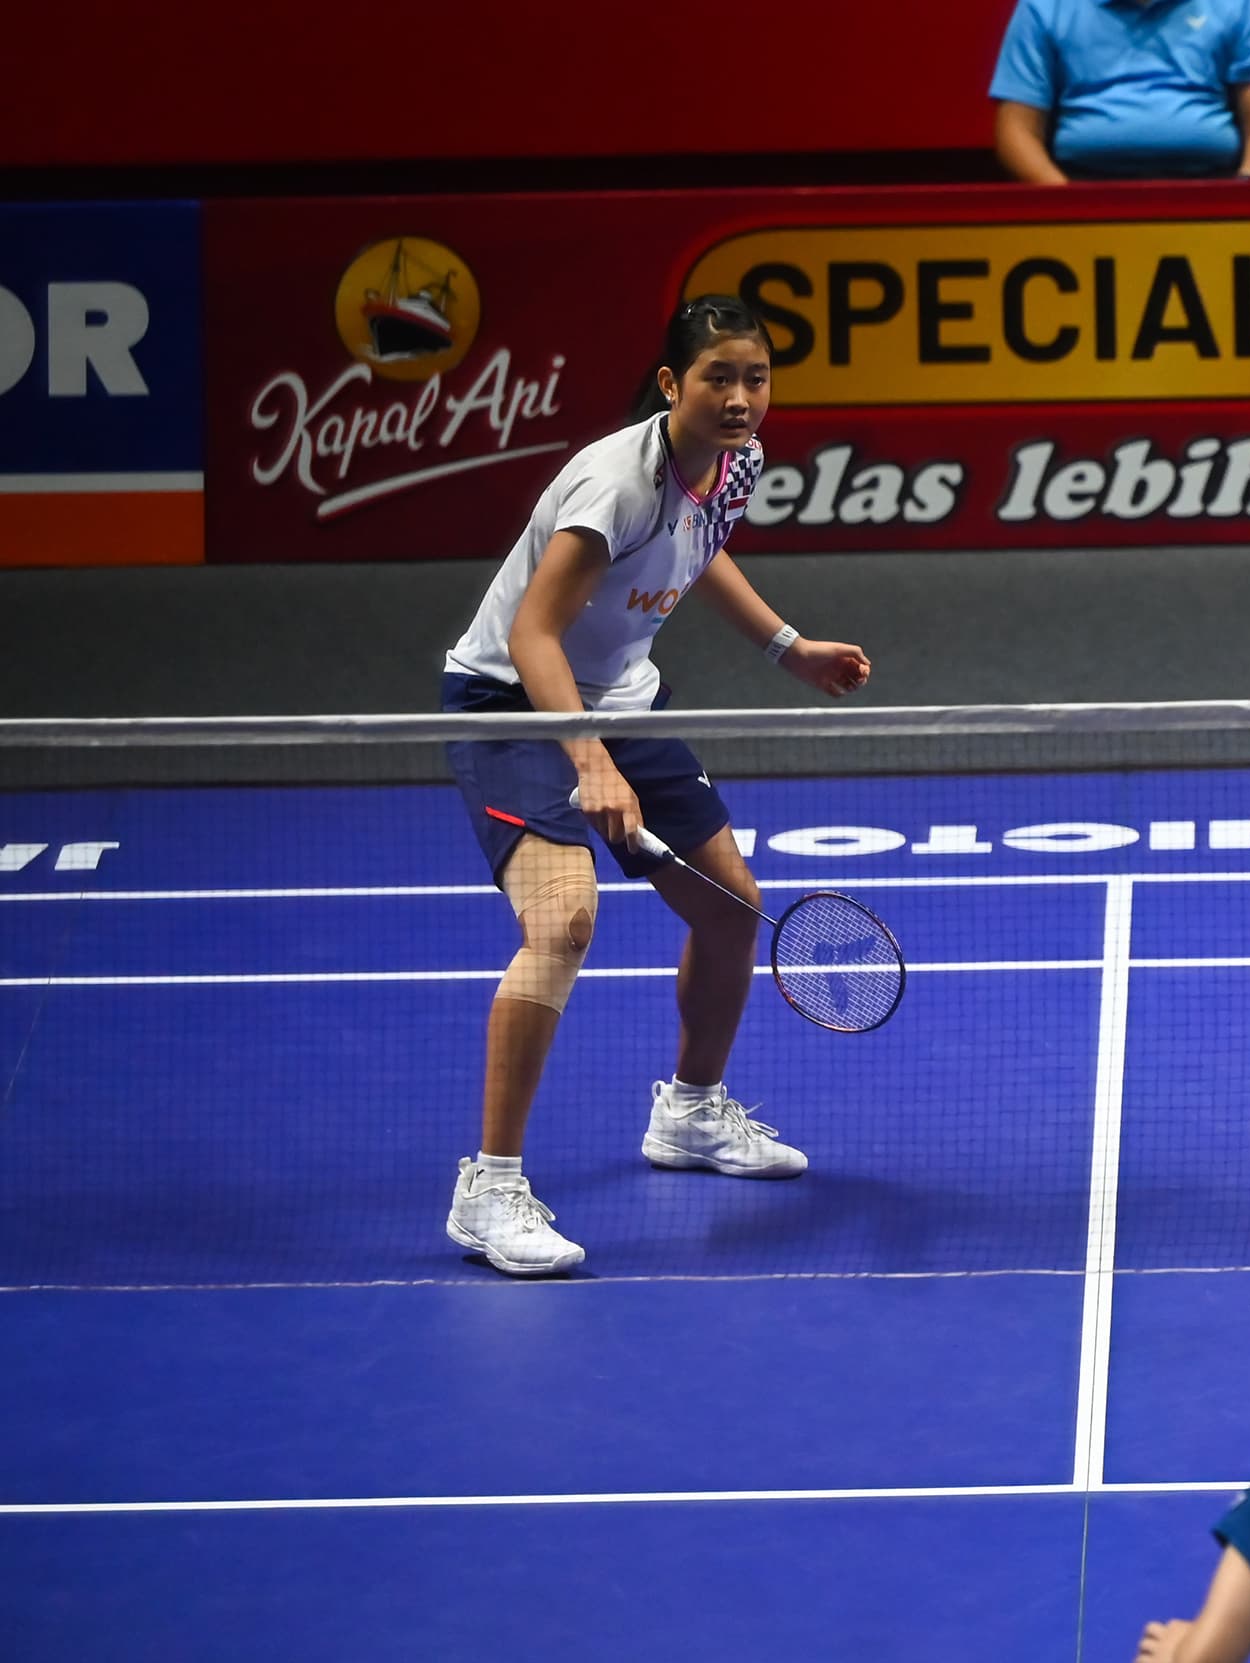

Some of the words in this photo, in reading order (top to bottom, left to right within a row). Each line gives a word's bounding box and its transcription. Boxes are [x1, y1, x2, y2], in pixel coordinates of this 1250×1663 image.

[251, 363, 440, 494] Kapal
[445, 347, 566, 448] Api
[743, 443, 963, 524] elas
